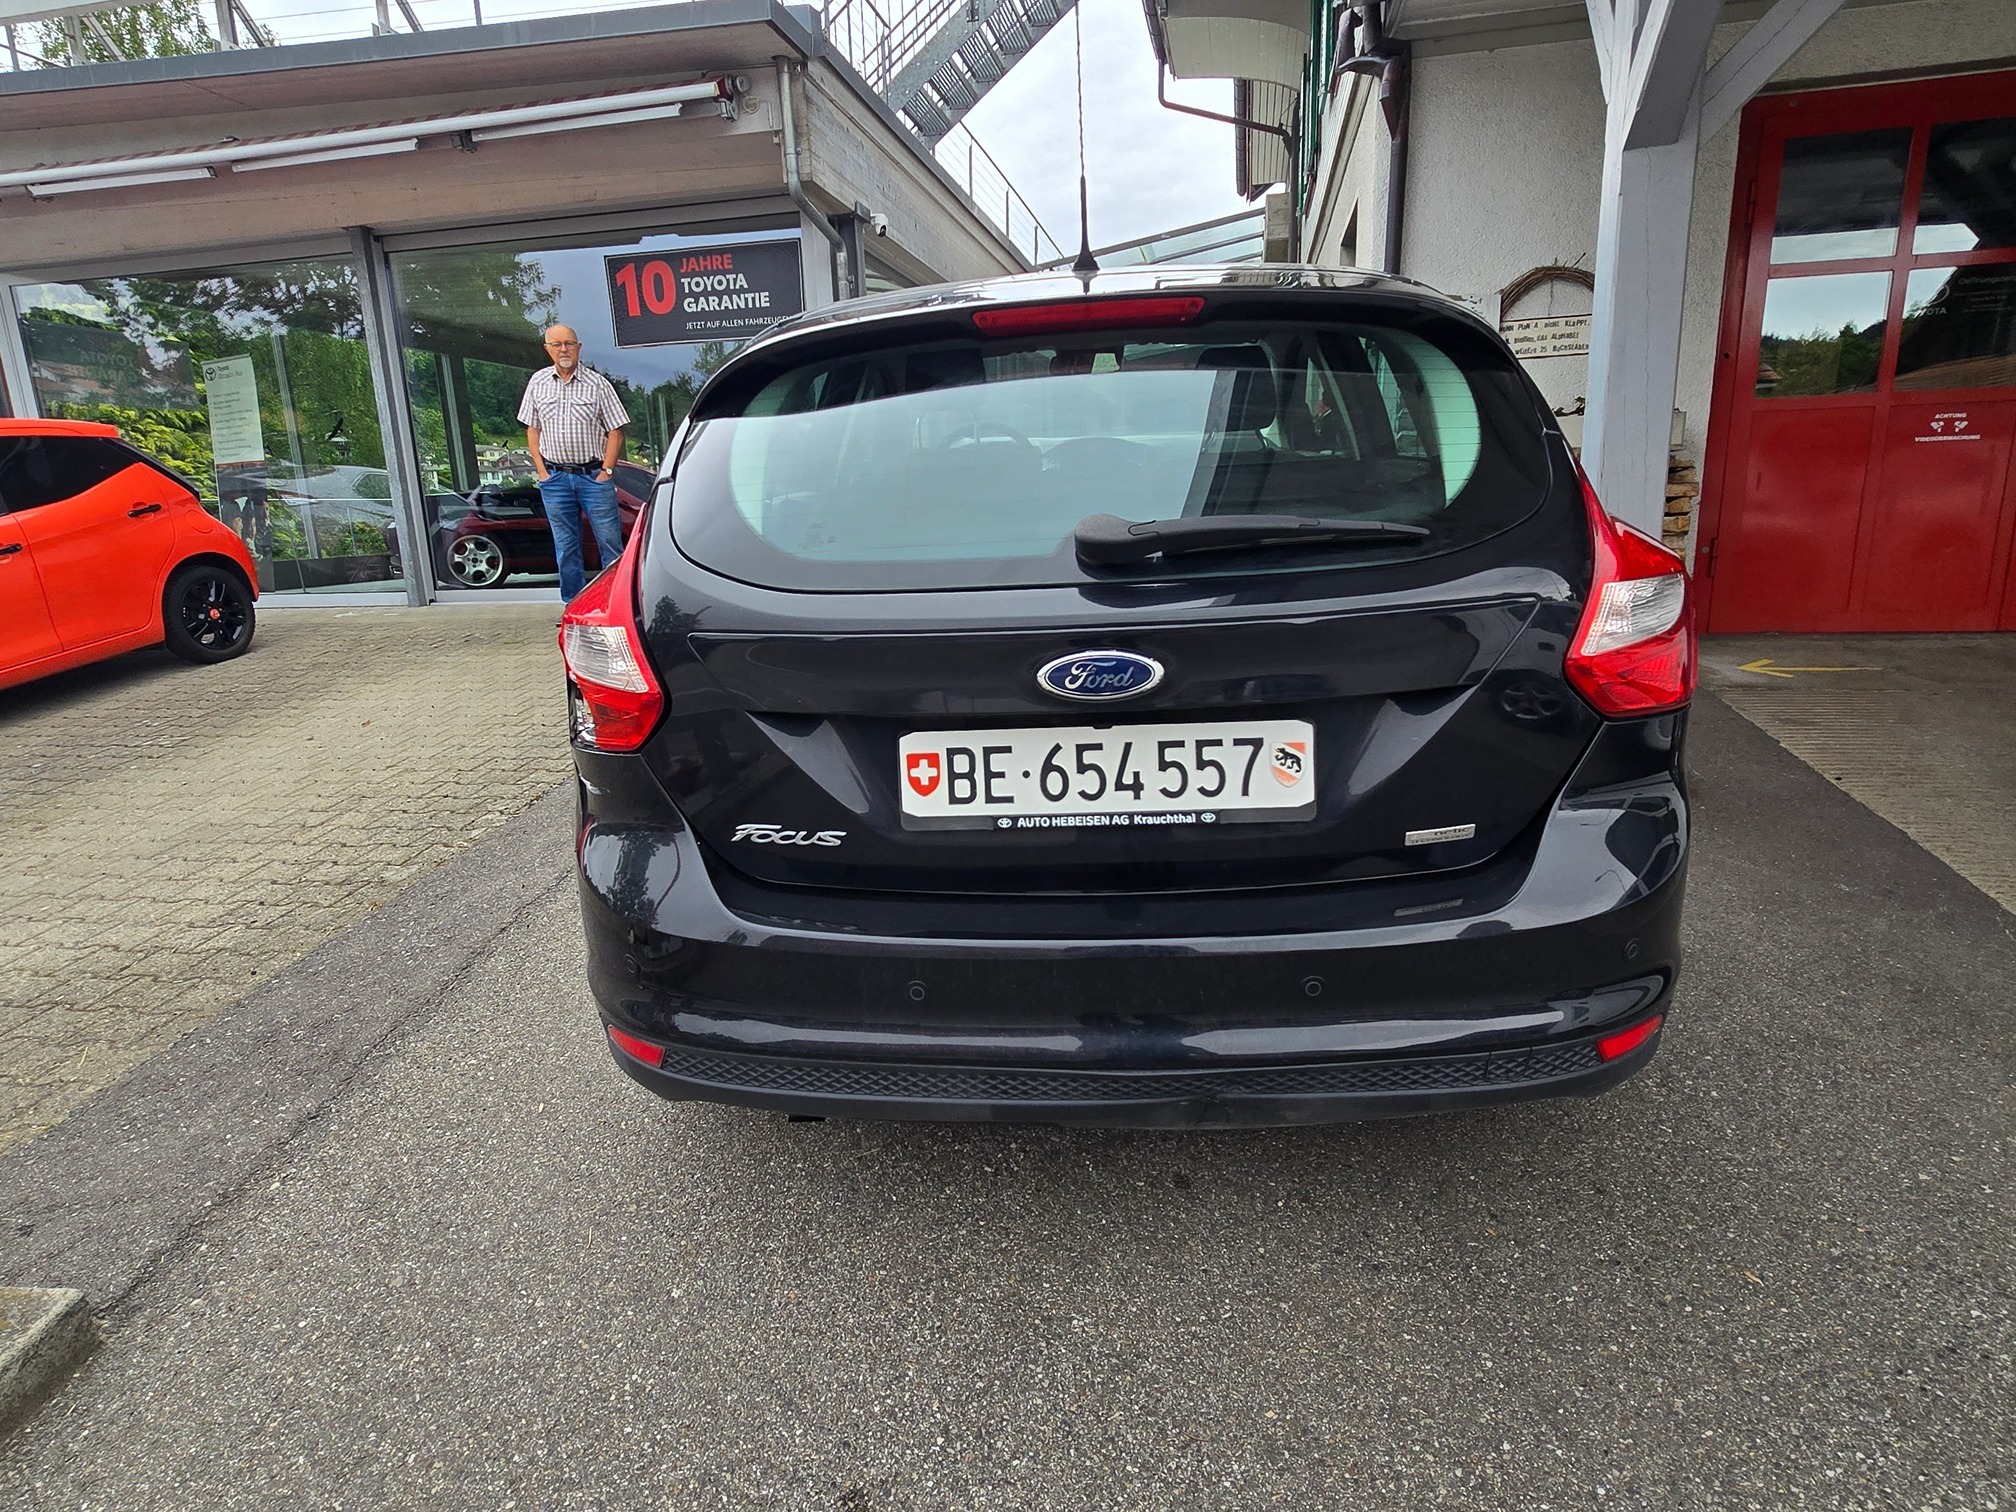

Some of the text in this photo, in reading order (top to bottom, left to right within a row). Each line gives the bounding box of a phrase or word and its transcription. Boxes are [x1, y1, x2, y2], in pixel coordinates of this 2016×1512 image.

[680, 253, 733, 273] JAHRE
[615, 260, 676, 317] 10
[681, 273, 748, 294] TOYOTA
[683, 291, 770, 313] GARANTIE
[686, 321, 705, 330] JETZT
[706, 320, 720, 329] AUF
[722, 319, 744, 327] ALLEN
[1064, 661, 1135, 689] Ford
[1017, 813, 1196, 828] AUTO HEBEISEN AG Krauchthal
